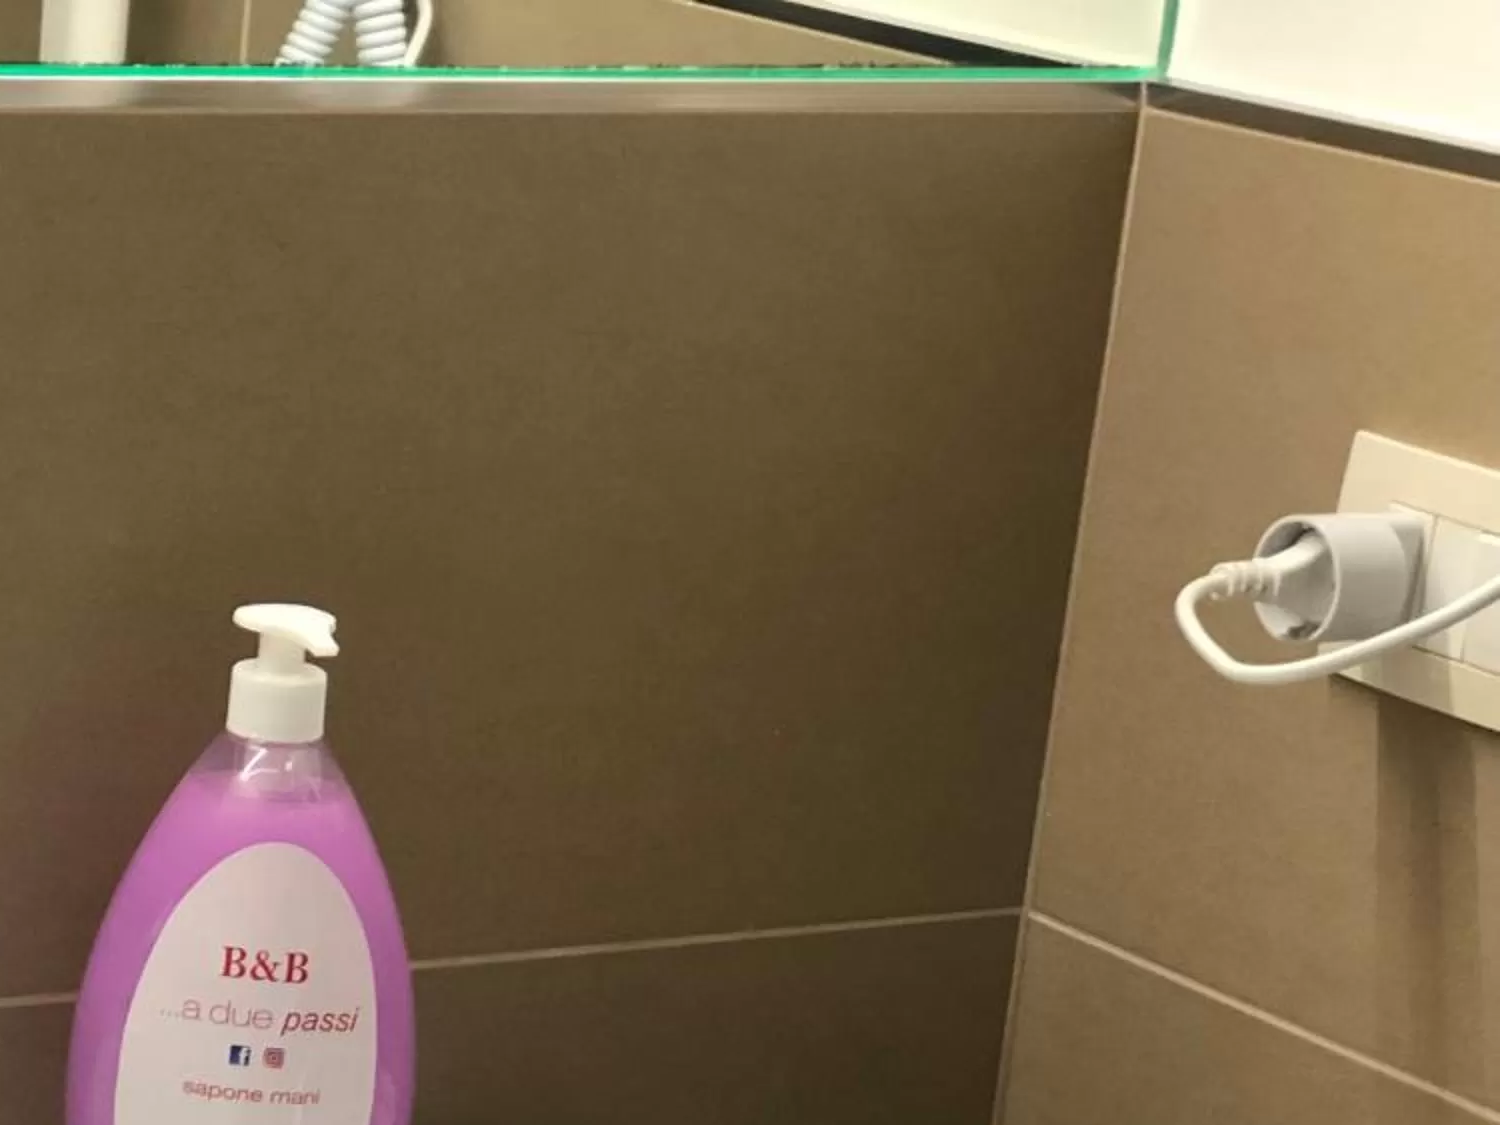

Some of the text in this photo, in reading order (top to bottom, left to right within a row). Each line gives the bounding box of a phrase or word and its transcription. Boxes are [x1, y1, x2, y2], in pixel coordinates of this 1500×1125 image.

[221, 945, 310, 984] B&B
[209, 1000, 274, 1030] due
[280, 1007, 360, 1036] passi
[182, 1080, 321, 1105] sapone mani
